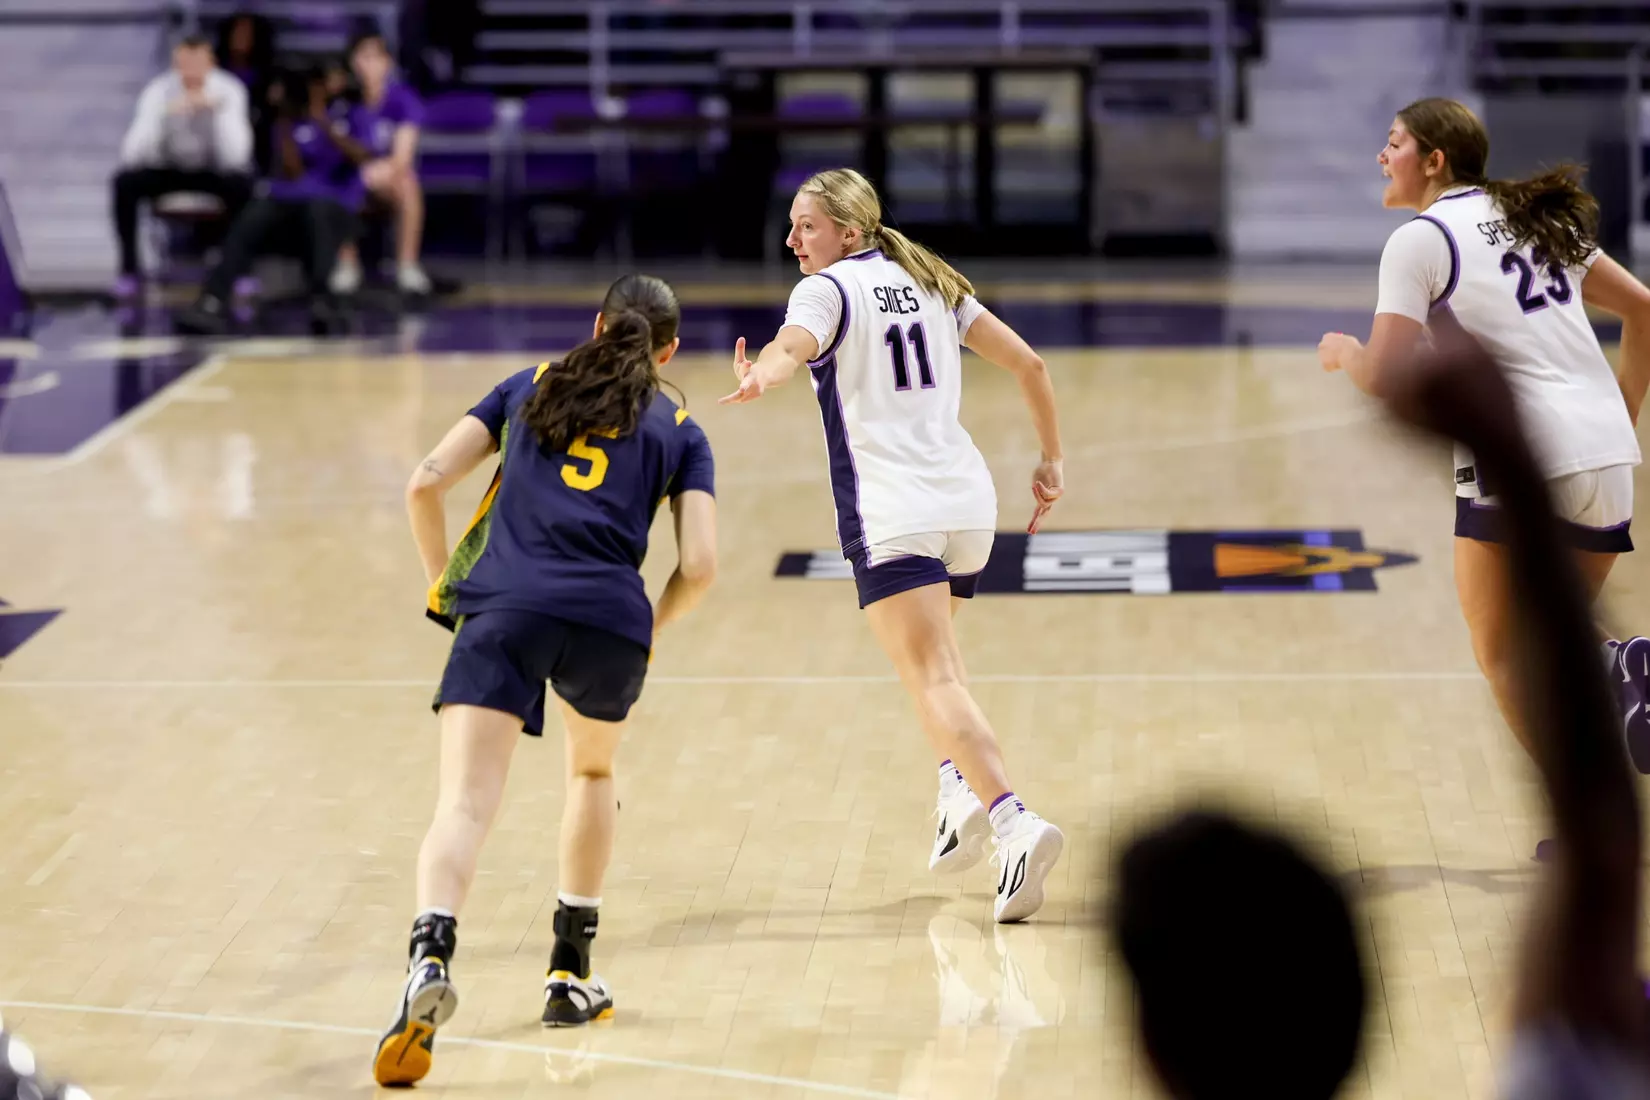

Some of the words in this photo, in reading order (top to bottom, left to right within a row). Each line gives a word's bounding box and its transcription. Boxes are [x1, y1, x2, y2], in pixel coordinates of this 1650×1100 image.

[1499, 246, 1573, 315] 23
[884, 321, 936, 391] 11
[560, 425, 619, 492] 5
